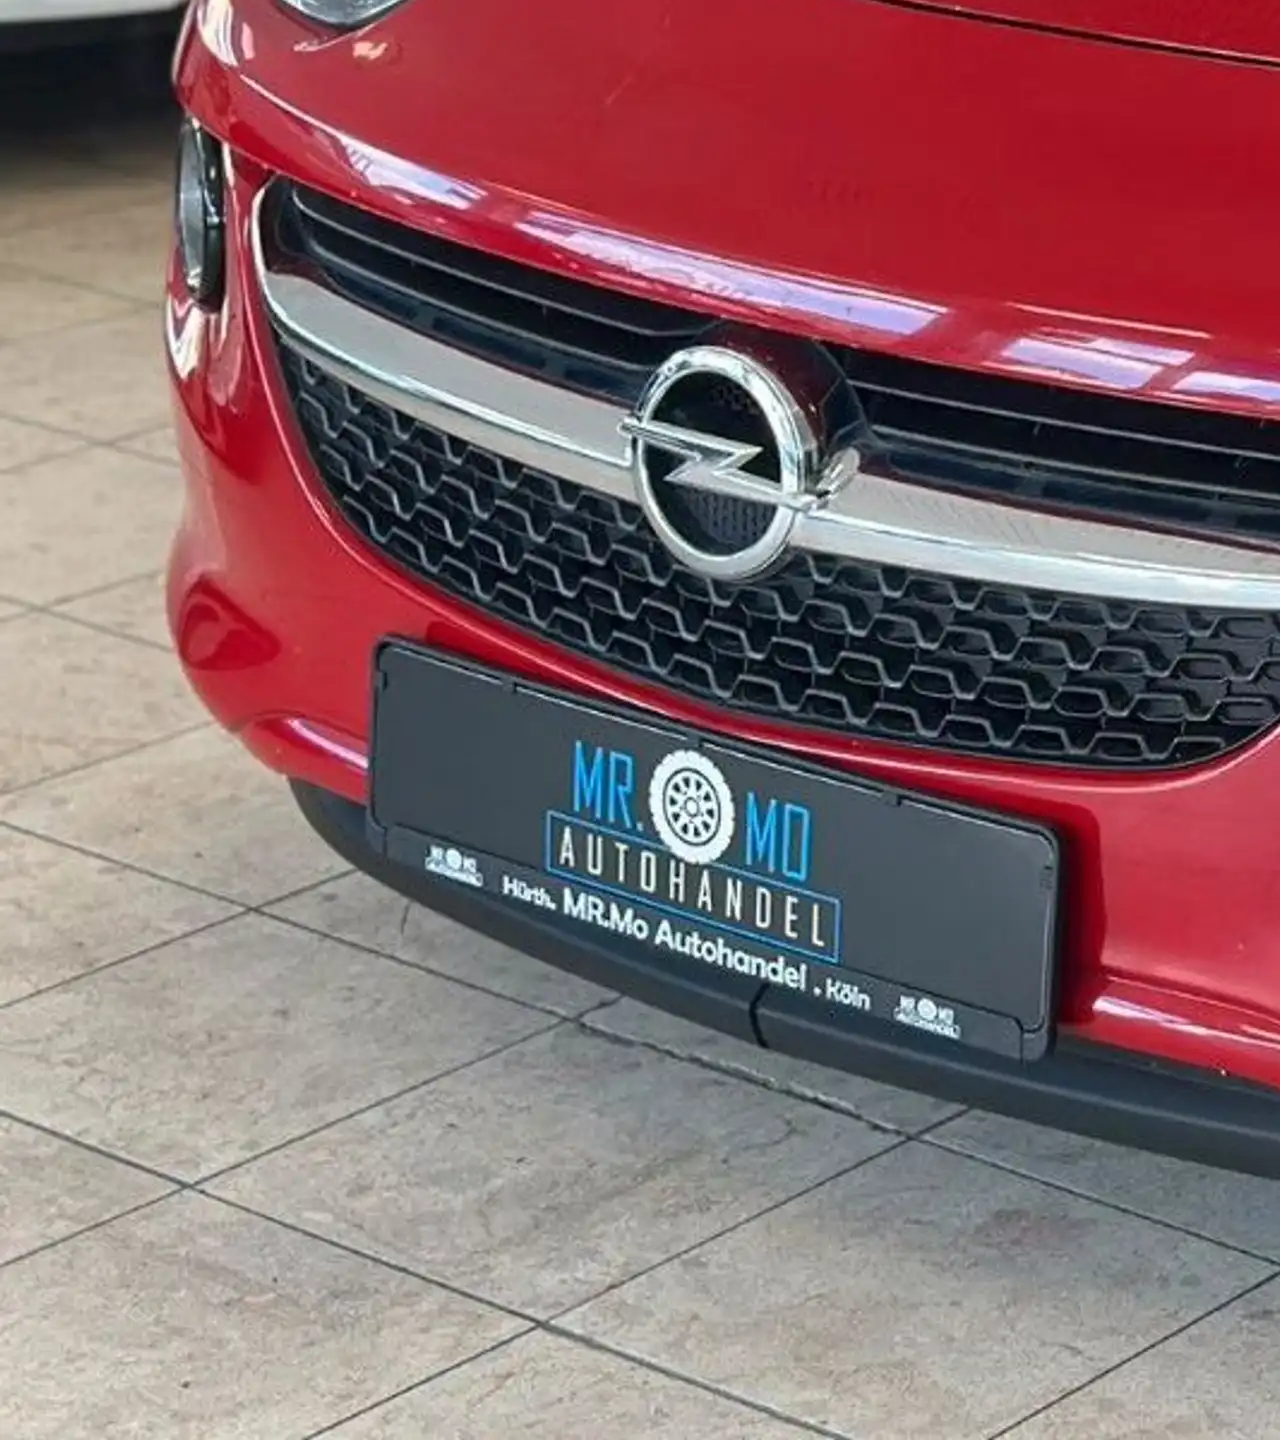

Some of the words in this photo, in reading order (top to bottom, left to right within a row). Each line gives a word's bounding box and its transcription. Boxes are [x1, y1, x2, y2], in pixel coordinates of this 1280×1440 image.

[573, 740, 644, 832] MR.
[746, 791, 811, 883] MO
[559, 825, 826, 948] AUTOHANDEL
[654, 919, 808, 992] Autohandel
[825, 977, 872, 1011] Köln
